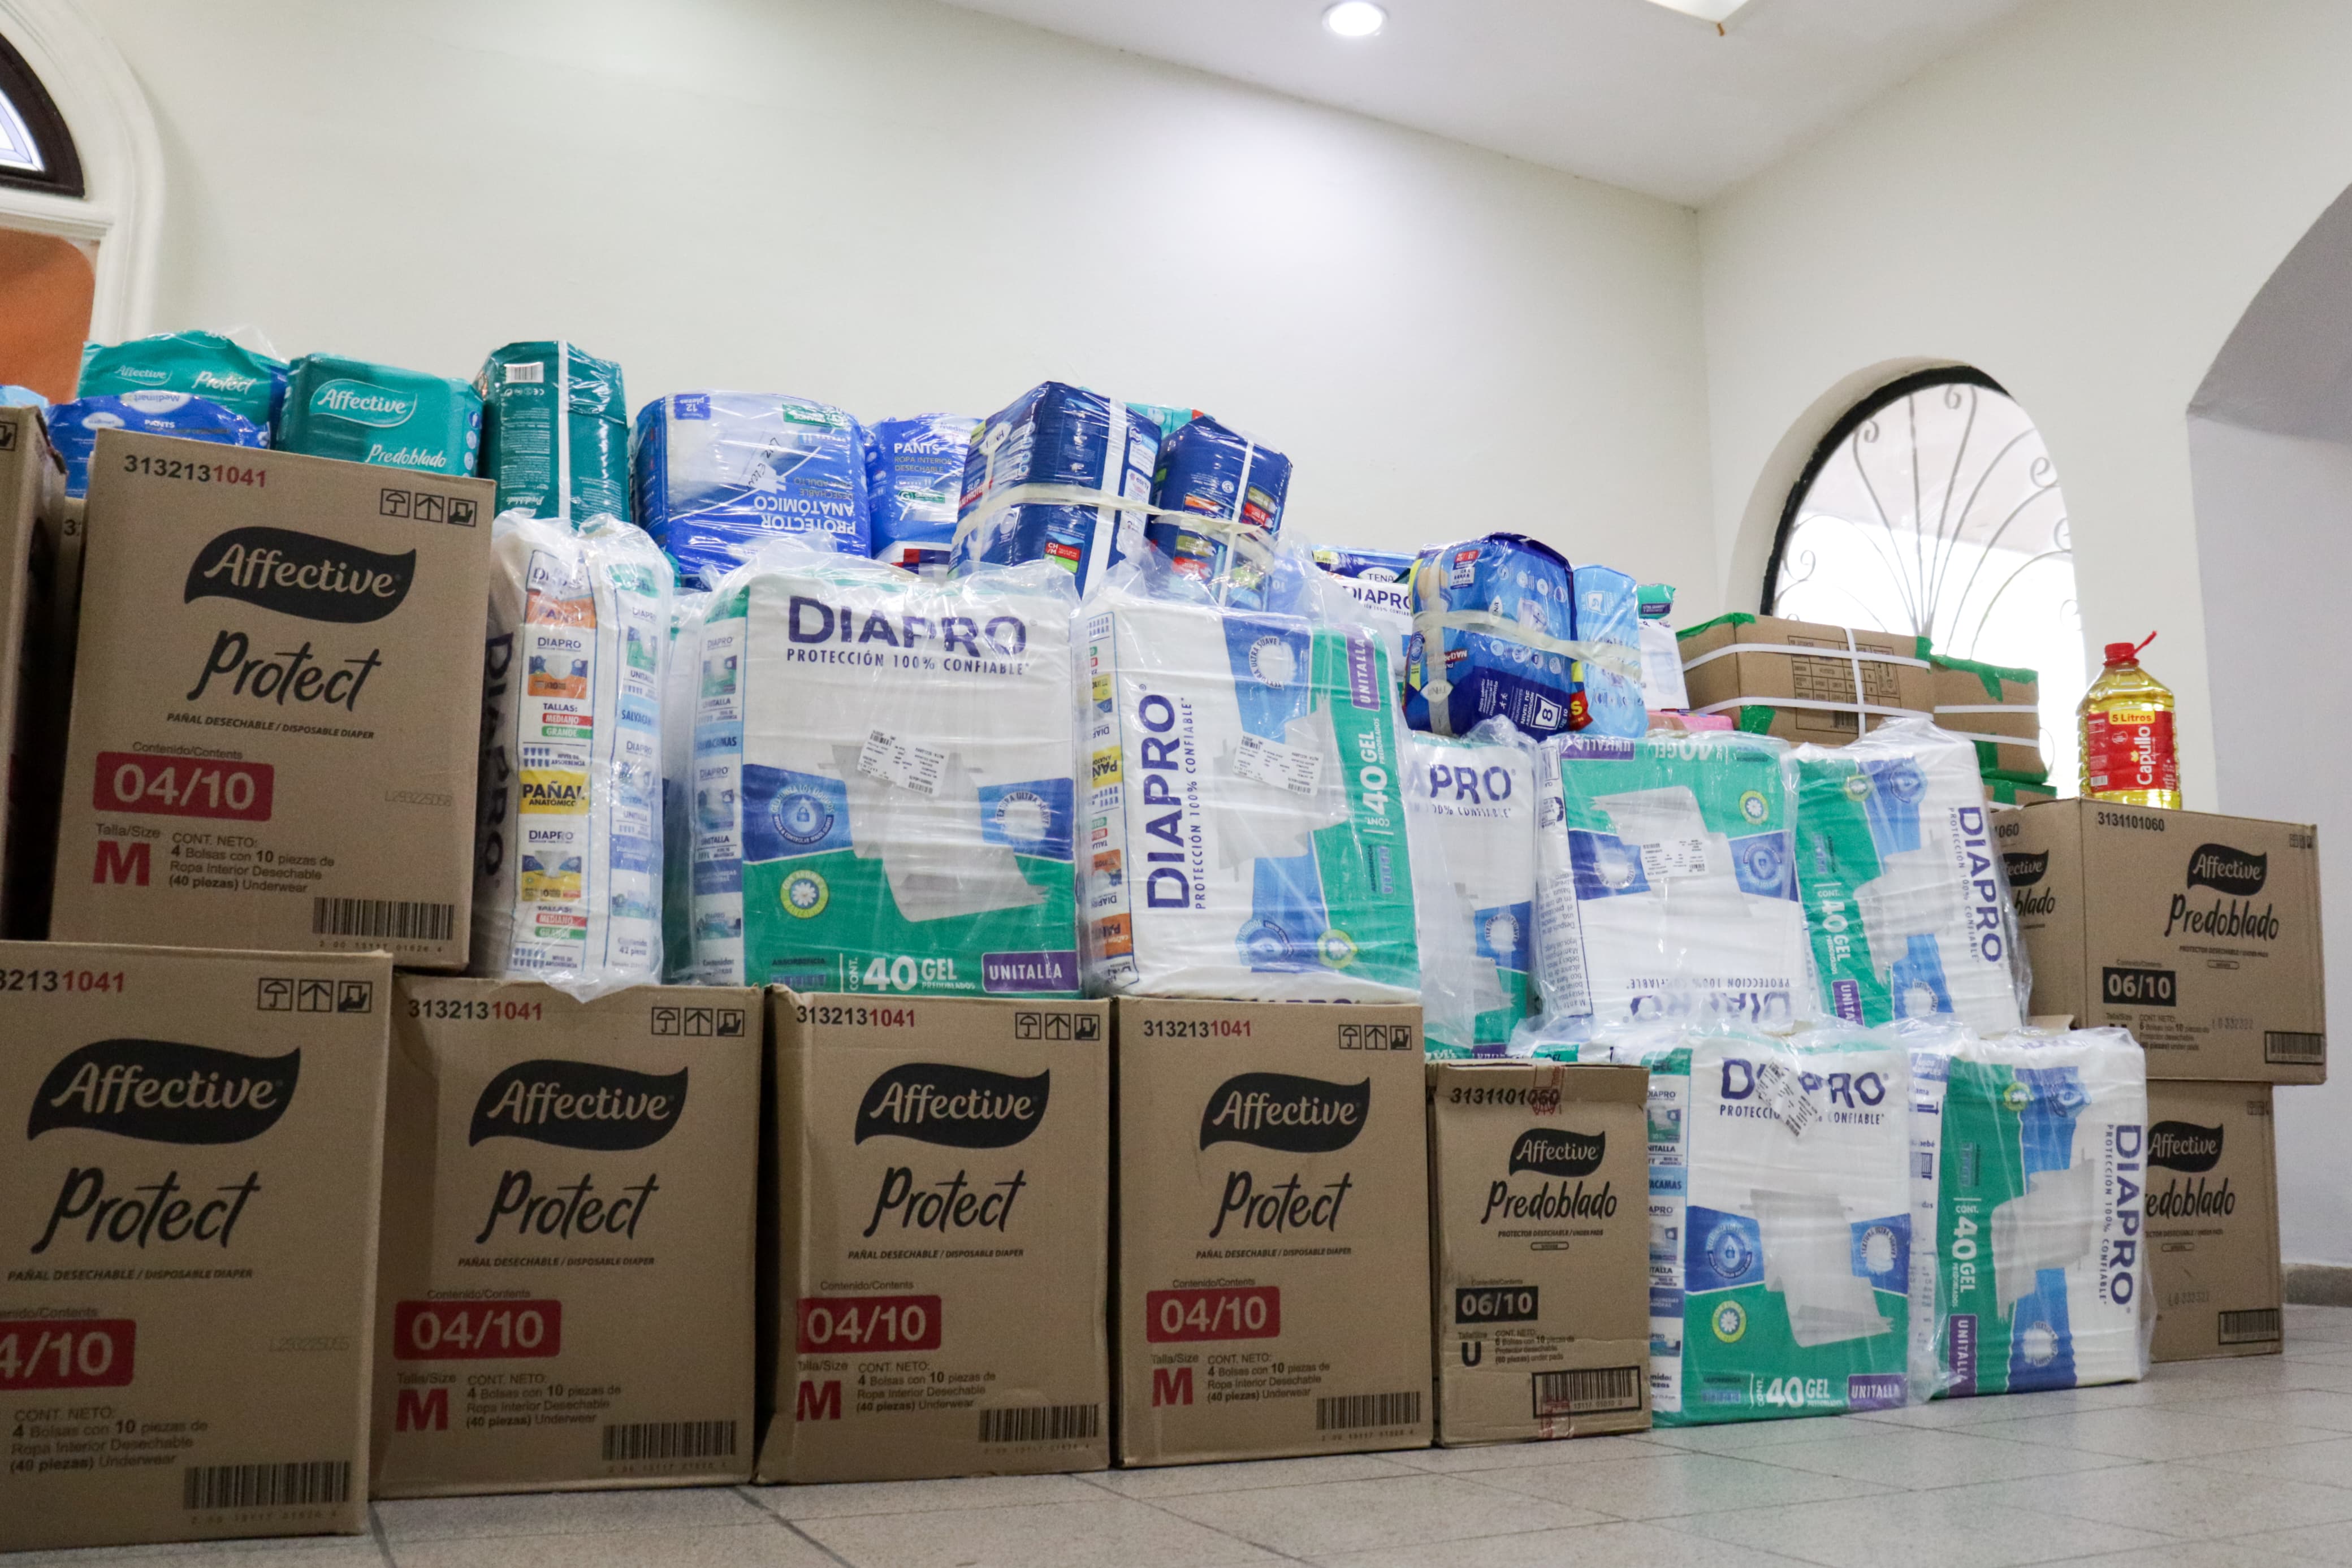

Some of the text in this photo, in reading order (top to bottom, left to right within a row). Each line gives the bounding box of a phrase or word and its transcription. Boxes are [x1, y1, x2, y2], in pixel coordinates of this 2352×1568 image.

[115, 366, 167, 379] Affective
[192, 370, 257, 394] Protect
[317, 388, 412, 416] Affective
[144, 419, 175, 428] PANTS
[365, 444, 447, 469] Predoblado
[894, 443, 940, 454] PANTS
[124, 455, 266, 488] 3132131041
[754, 496, 854, 517] ANATÓMICO
[761, 515, 856, 534] PROTECTOR
[204, 543, 396, 597] Affective
[1368, 574, 1394, 582] TENA
[789, 595, 1027, 658] DIAPRO
[538, 637, 581, 649] DIAPRO
[1257, 638, 1277, 648] SUAVE
[187, 630, 382, 712] Protect
[787, 648, 884, 666] PROTECCIÓN
[893, 655, 935, 669] 100%
[1355, 638, 1372, 705] UNITALLA
[543, 703, 578, 712] TALLAS:
[546, 714, 580, 725] MEDIANO
[1542, 708, 1553, 721] 8
[1571, 701, 1583, 716] S
[2121, 713, 2152, 722] Litros
[167, 712, 374, 740] PAÑAL DESECHABLE DISPOSABLE DIAPER
[132, 741, 243, 760] Contenido/Contents
[2137, 726, 2156, 785] Capullo
[1360, 731, 1389, 815] 40 GEL
[113, 763, 256, 811] 04/10
[1187, 779, 1201, 818] 100%
[1138, 694, 1191, 909] DIAPRO
[97, 824, 161, 839] Talla/Size
[2098, 812, 2164, 831] 3131101060
[92, 840, 151, 886] M
[171, 846, 335, 868] 4 Bolsas con 10 piezas de
[1188, 831, 1206, 909] PROTECCIÓN
[2192, 852, 2261, 881] Affective
[170, 861, 322, 881] Ropa Interior Desechable
[243, 880, 308, 894] Underwear
[1958, 806, 2002, 963] DIAPRO
[2164, 893, 2279, 941] Predoblado
[1821, 900, 1851, 962] 40 GEL
[863, 956, 957, 990] 40 GEL
[989, 963, 1062, 981] UNITALLA
[2108, 973, 2171, 999] 06/10
[408, 999, 543, 1020] 3132131041
[796, 1006, 915, 1028] 3132131041
[1144, 1020, 1251, 1038] 3132131041
[50, 1061, 276, 1114] Affective
[1450, 1087, 1560, 1106] 3131101060
[487, 1078, 671, 1125] Affective
[870, 1081, 1035, 1124] Affective
[1212, 1090, 1357, 1130] Affective
[1516, 1139, 1599, 1163] Affective
[2148, 1133, 2217, 1158] Affective
[30, 1167, 261, 1255] Protect
[475, 1169, 659, 1244] Protect
[863, 1167, 1027, 1238] Protect
[1209, 1171, 1352, 1238] Protect
[1481, 1180, 1618, 1225] Predoblado
[1955, 1205, 1979, 1214] CONT.
[2109, 1125, 2142, 1305] DIAPRO
[458, 1255, 654, 1267] PAÑAL DESECHABLE DISPOSABLE DIAPER
[848, 1248, 1024, 1260] PAÑAL DESECHABLE DISPOSABLE DIAPER
[1196, 1247, 1352, 1259] PAÑAL DESECHABLE DISPOSABLE DIAPER
[1952, 1216, 1977, 1293] 40 GEL
[7, 1269, 50, 1281] PAÑAL
[53, 1268, 134, 1280] DESECHABLE
[820, 1281, 914, 1291] Contenido/Contents
[1173, 1277, 1256, 1289] Contenido/Contents
[427, 1289, 531, 1300] Contenido/Contents
[1462, 1292, 1533, 1316] 06/10
[807, 1306, 927, 1344] 04/10
[1160, 1296, 1267, 1334] 04/10
[411, 1310, 544, 1351] 04/10
[1462, 1341, 1481, 1367] U
[1152, 1367, 1194, 1407] M
[1766, 1377, 1830, 1407] 40 GEL
[396, 1388, 448, 1432] M
[796, 1380, 841, 1422] M
